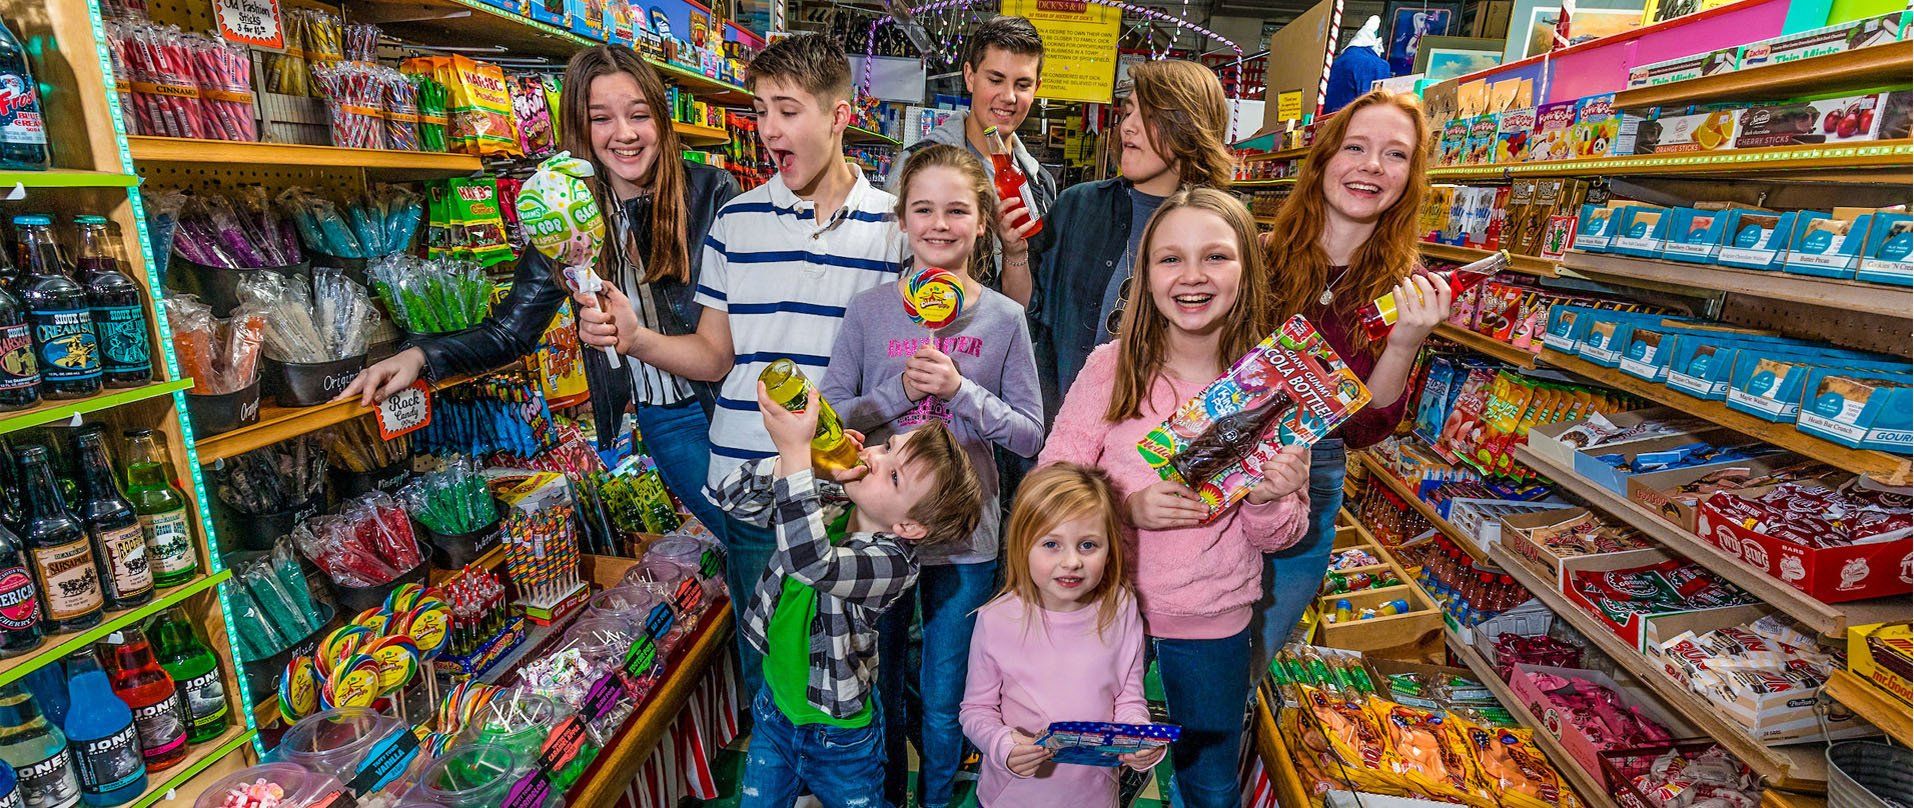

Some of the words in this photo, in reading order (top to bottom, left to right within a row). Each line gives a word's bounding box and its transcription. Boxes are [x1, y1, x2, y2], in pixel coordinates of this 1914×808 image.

[242, 1, 270, 17] Fashion
[1038, 1, 1064, 11] DICK'S
[239, 12, 261, 24] Sticks
[1775, 55, 1800, 64] Thin
[1803, 46, 1840, 59] Mints
[1652, 77, 1669, 85] Thin
[1655, 146, 1677, 154] ORANGE
[1679, 144, 1699, 152] STICKS
[1737, 136, 1763, 146] CHERRY
[1765, 136, 1790, 145] STICKS
[537, 218, 562, 235] POP
[1801, 255, 1815, 263] Butter
[1816, 256, 1830, 264] Pecan
[1867, 260, 1889, 269] Cookies
[55, 313, 79, 325] SIOUX
[110, 310, 131, 320] SIOUX
[36, 322, 80, 343] CREAM
[1286, 349, 1309, 371] GIANT
[1305, 371, 1333, 398] GUMMY
[1264, 348, 1295, 378] COLA
[1288, 375, 1336, 419] BOTTLE!
[389, 390, 420, 412] Rock
[394, 406, 419, 421] Candy
[1808, 416, 1823, 425] Heath
[1823, 420, 1833, 428] Bar
[1833, 423, 1853, 434] Crunch
[1514, 535, 1539, 562] BUN
[1719, 534, 1743, 557] TWIN
[1743, 546, 1771, 572] BING
[1782, 544, 1804, 556] BARS
[0, 615, 30, 627] CHERRY
[88, 721, 137, 752] JONES
[19, 747, 69, 778] ONES
[375, 749, 405, 777] VANILLA
